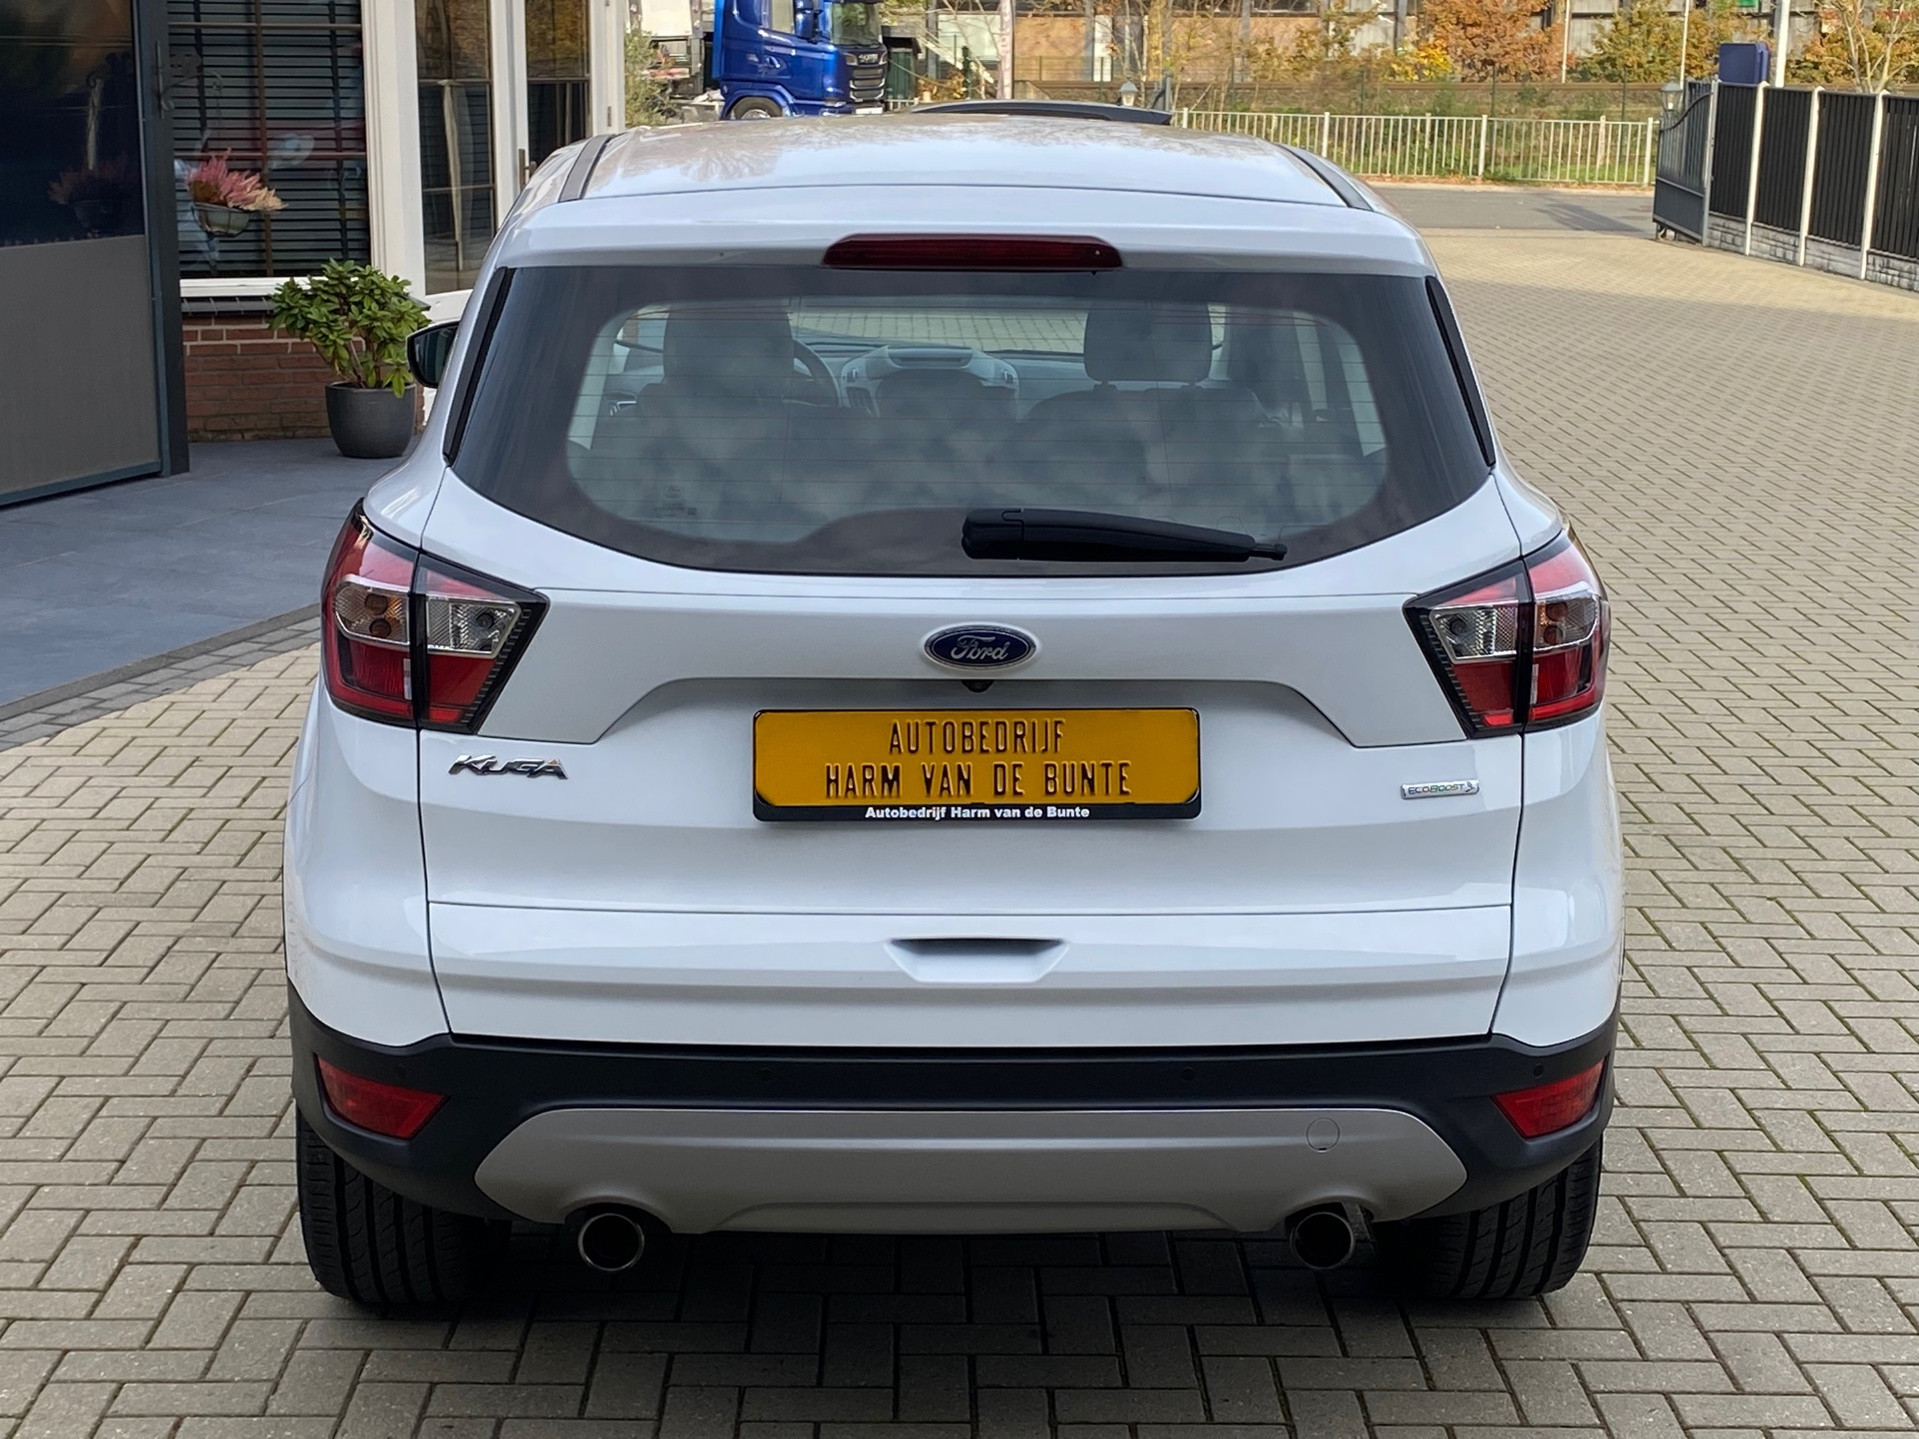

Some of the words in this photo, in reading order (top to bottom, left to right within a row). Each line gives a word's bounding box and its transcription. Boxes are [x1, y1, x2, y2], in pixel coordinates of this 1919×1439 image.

[950, 635, 1011, 660] Ford
[889, 719, 1065, 754] AUTOBEDRIJF
[448, 754, 568, 780] KUGA
[825, 762, 902, 798] HARM
[921, 761, 973, 797] VAN
[993, 761, 1025, 796] DE
[1043, 760, 1131, 796] BUNTE
[865, 806, 946, 820] Autobedrijf
[951, 806, 990, 818] Harm
[995, 808, 1021, 818] van
[1025, 806, 1043, 818] de
[1047, 806, 1091, 818] Bunte
